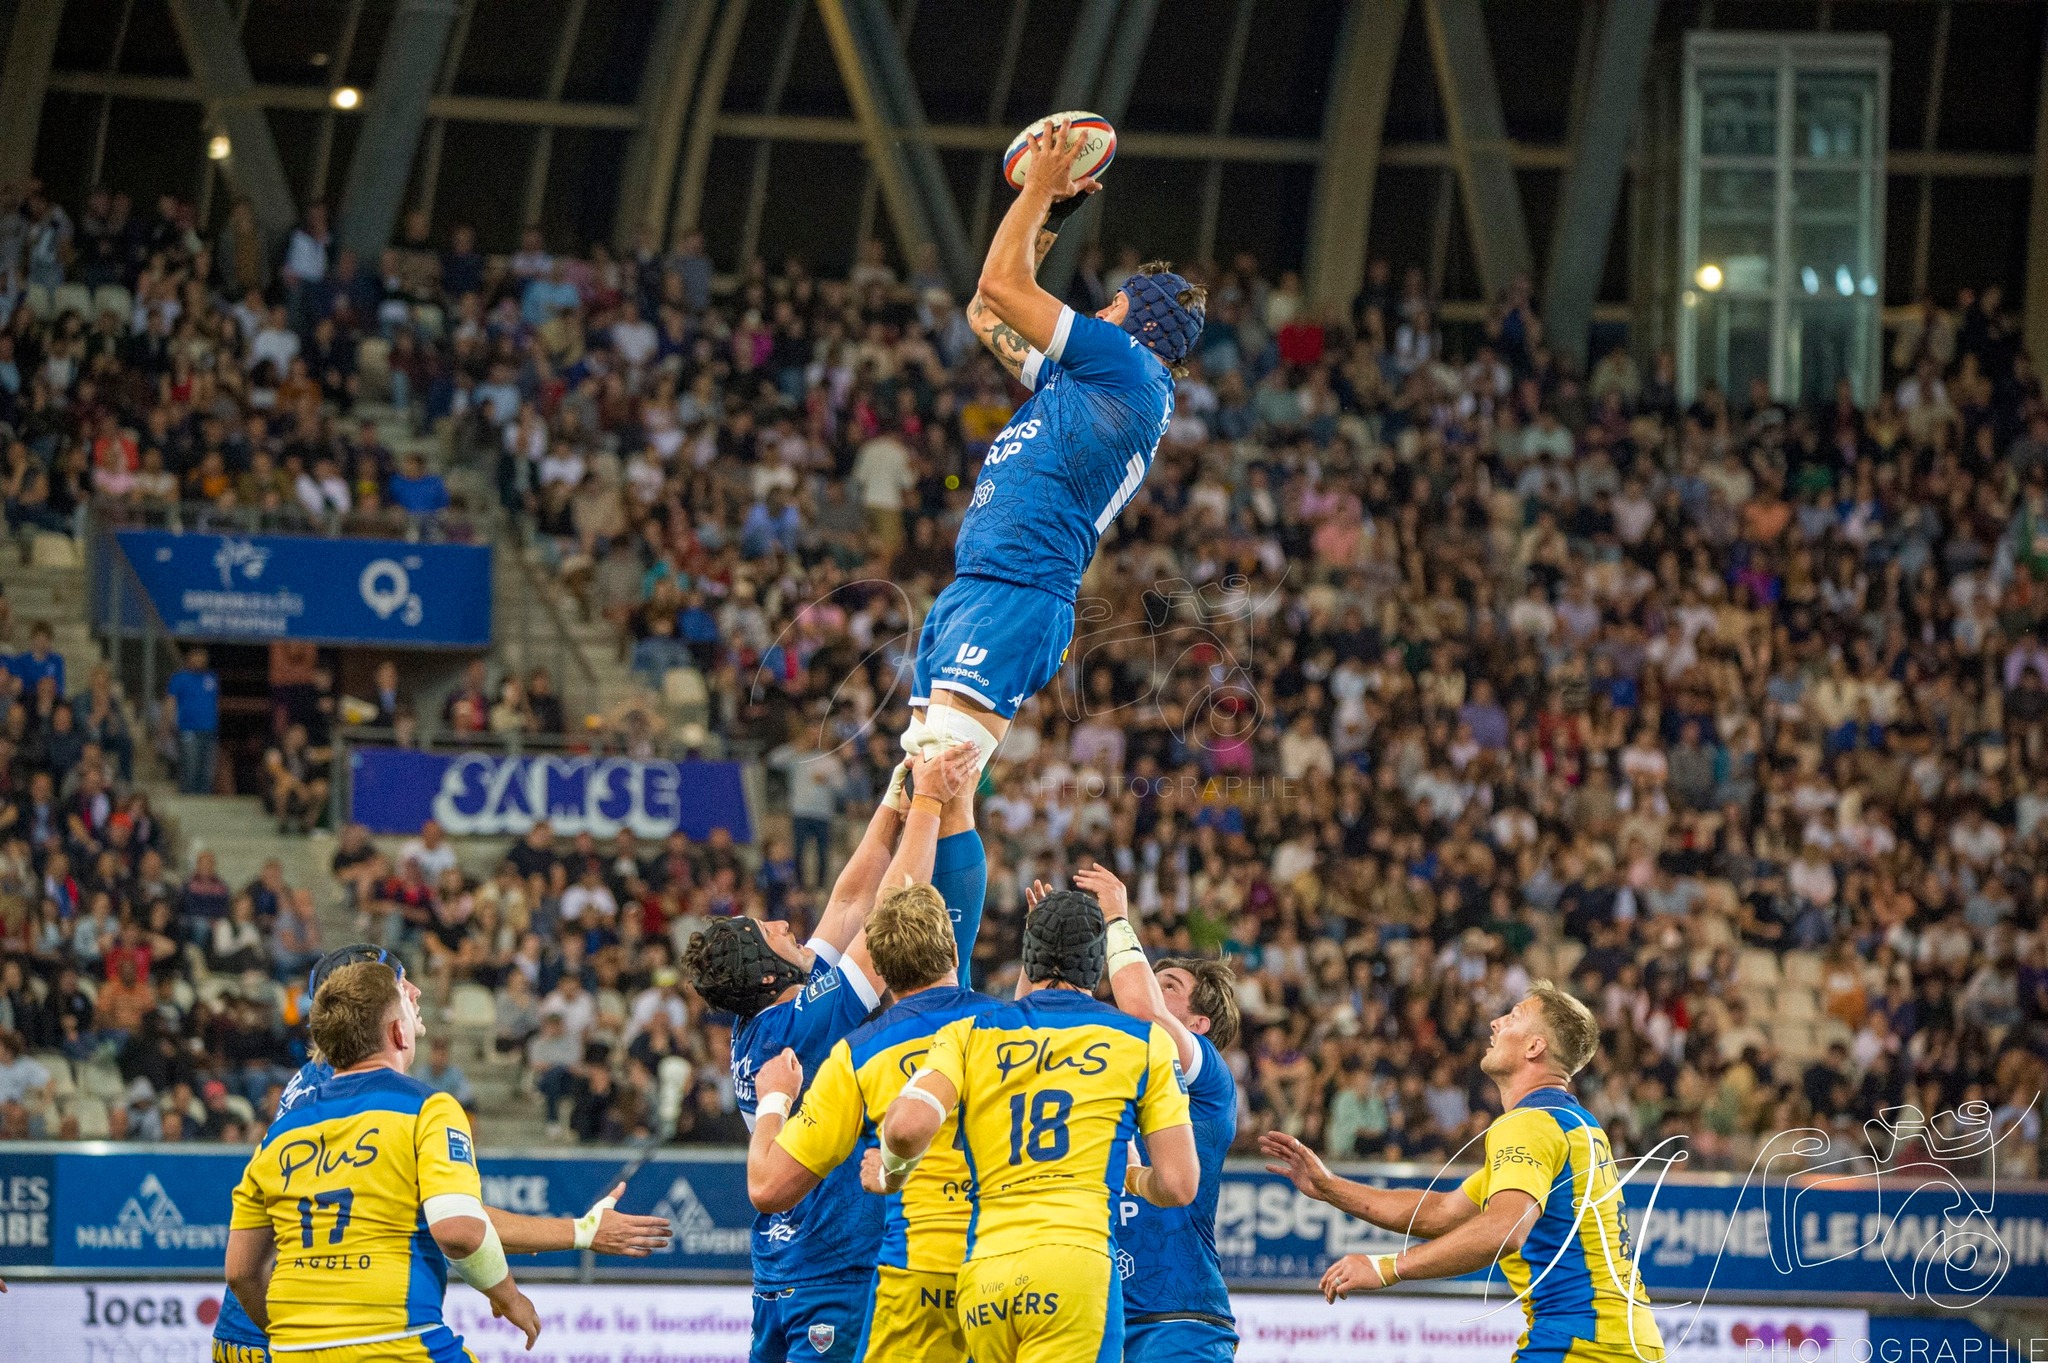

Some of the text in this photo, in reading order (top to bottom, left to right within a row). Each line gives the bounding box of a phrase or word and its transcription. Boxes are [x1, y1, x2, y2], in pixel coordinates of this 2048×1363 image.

[941, 664, 990, 688] weepackup
[432, 752, 682, 841] SAMSE
[1008, 1088, 1074, 1167] 18
[1493, 1154, 1543, 1172] SPORT
[297, 1186, 354, 1249] 17
[293, 1254, 371, 1270] AGGLO
[981, 1273, 1030, 1295] Ville de
[83, 1285, 185, 1327] loca
[966, 1292, 1060, 1331] NEVERS
